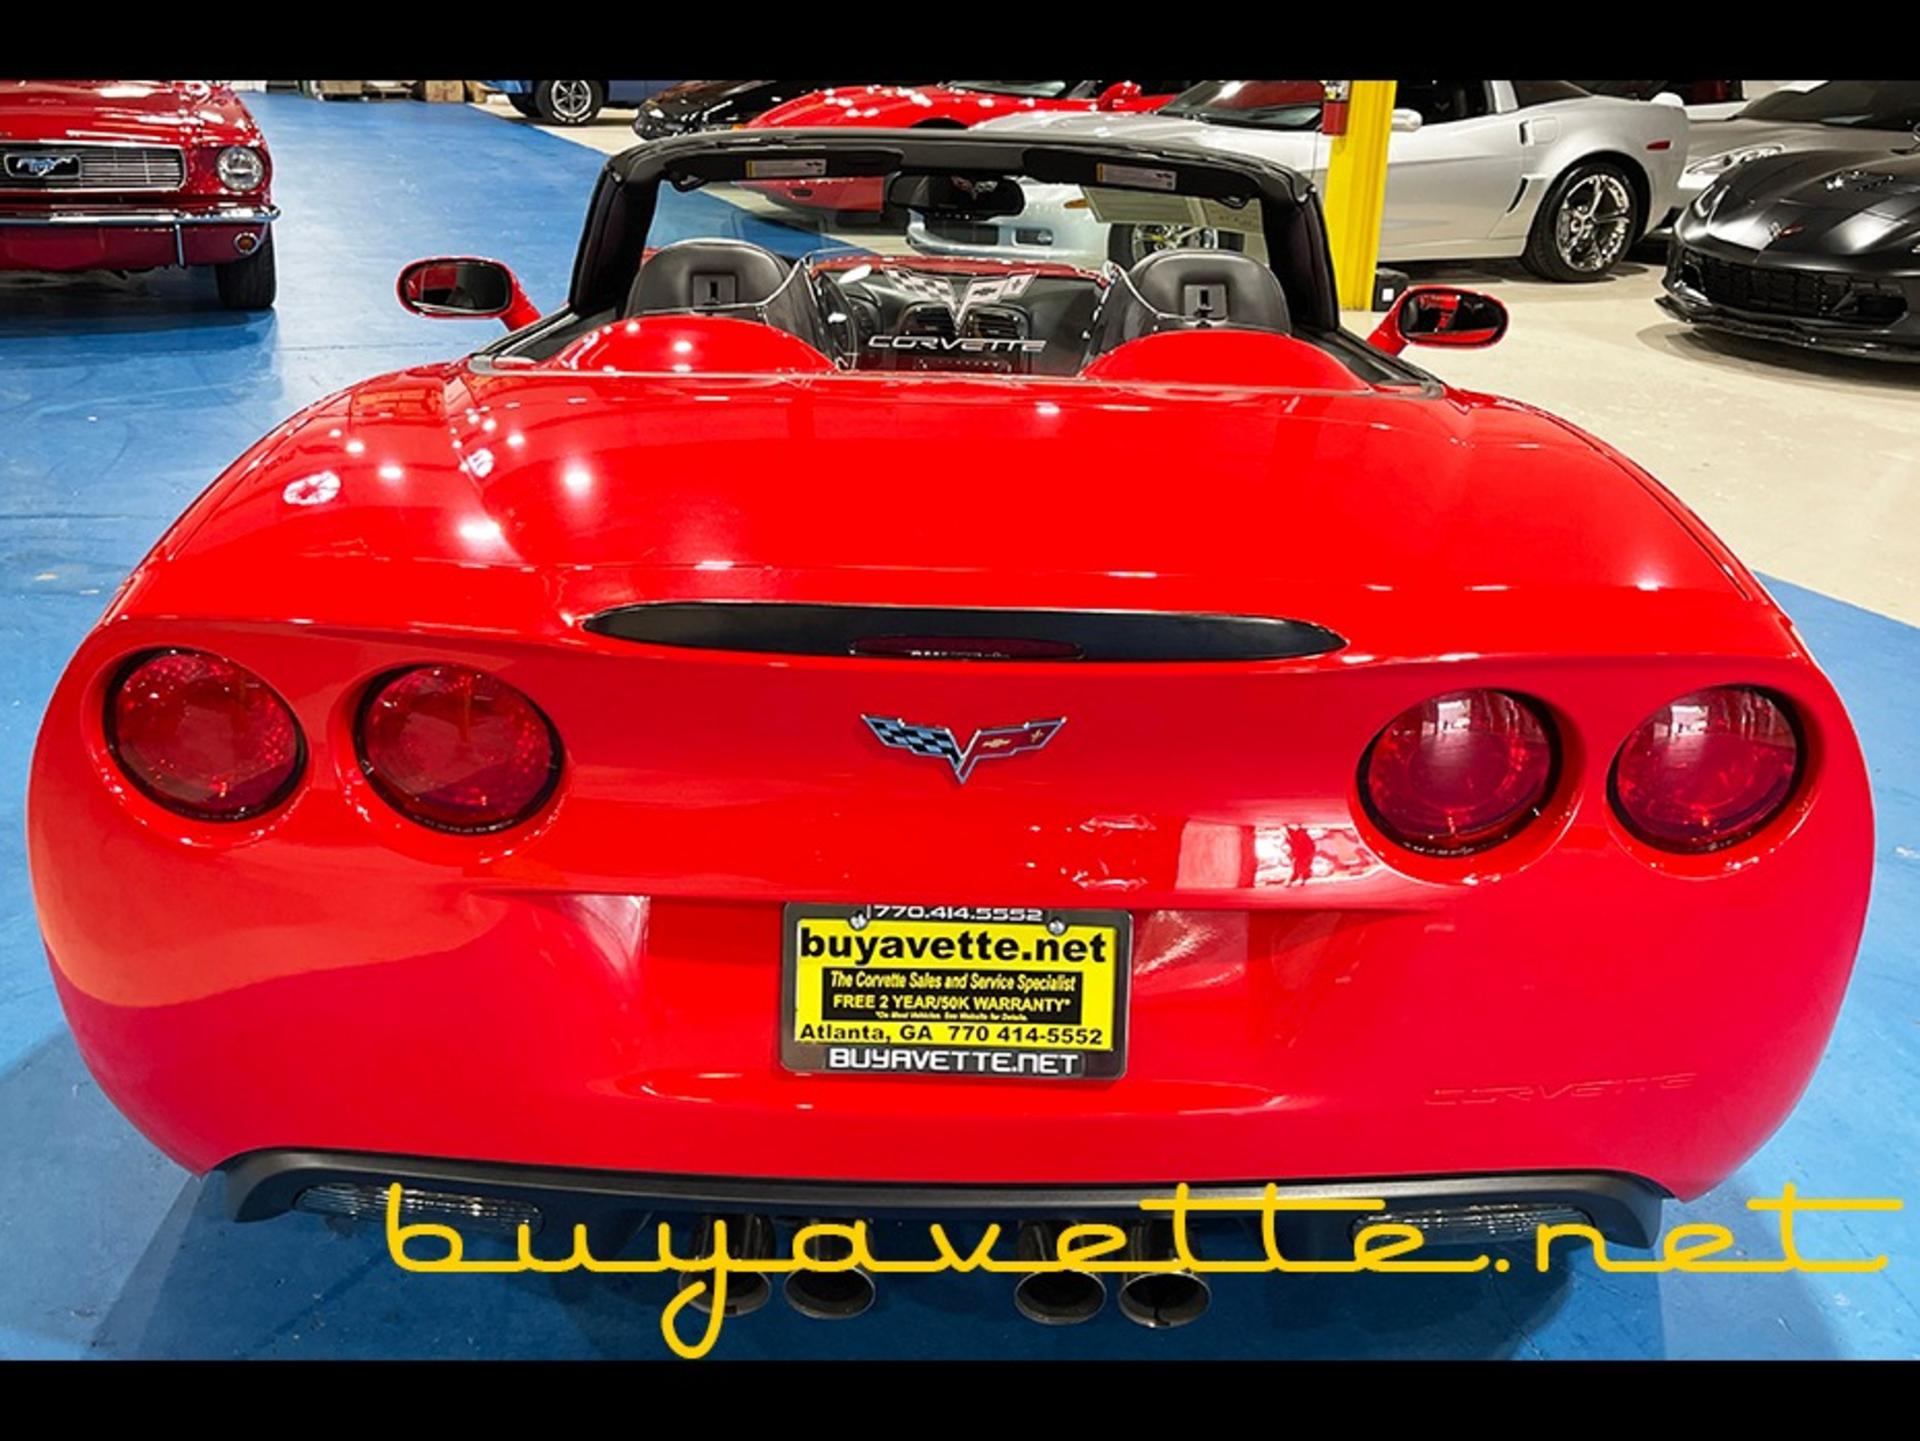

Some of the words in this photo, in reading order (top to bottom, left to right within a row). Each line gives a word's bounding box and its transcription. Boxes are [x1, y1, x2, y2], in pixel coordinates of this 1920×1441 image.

[868, 335, 1047, 352] CORVETTE
[873, 904, 1043, 922] 770.414.5552
[800, 927, 1106, 965] buyavette.net
[831, 970, 853, 987] The
[856, 971, 905, 988] Corvette
[909, 972, 942, 989] Sales
[945, 973, 967, 990] and
[971, 973, 1014, 991] Service
[1017, 974, 1076, 994] Specialist
[833, 994, 875, 1009] FREE
[879, 995, 889, 1009] 2
[892, 995, 972, 1011] YEAR/50K
[800, 1023, 892, 1044] Atlanta,
[899, 1024, 933, 1041] GA
[949, 1025, 990, 1042] 770
[997, 1026, 1103, 1046] 414-5552
